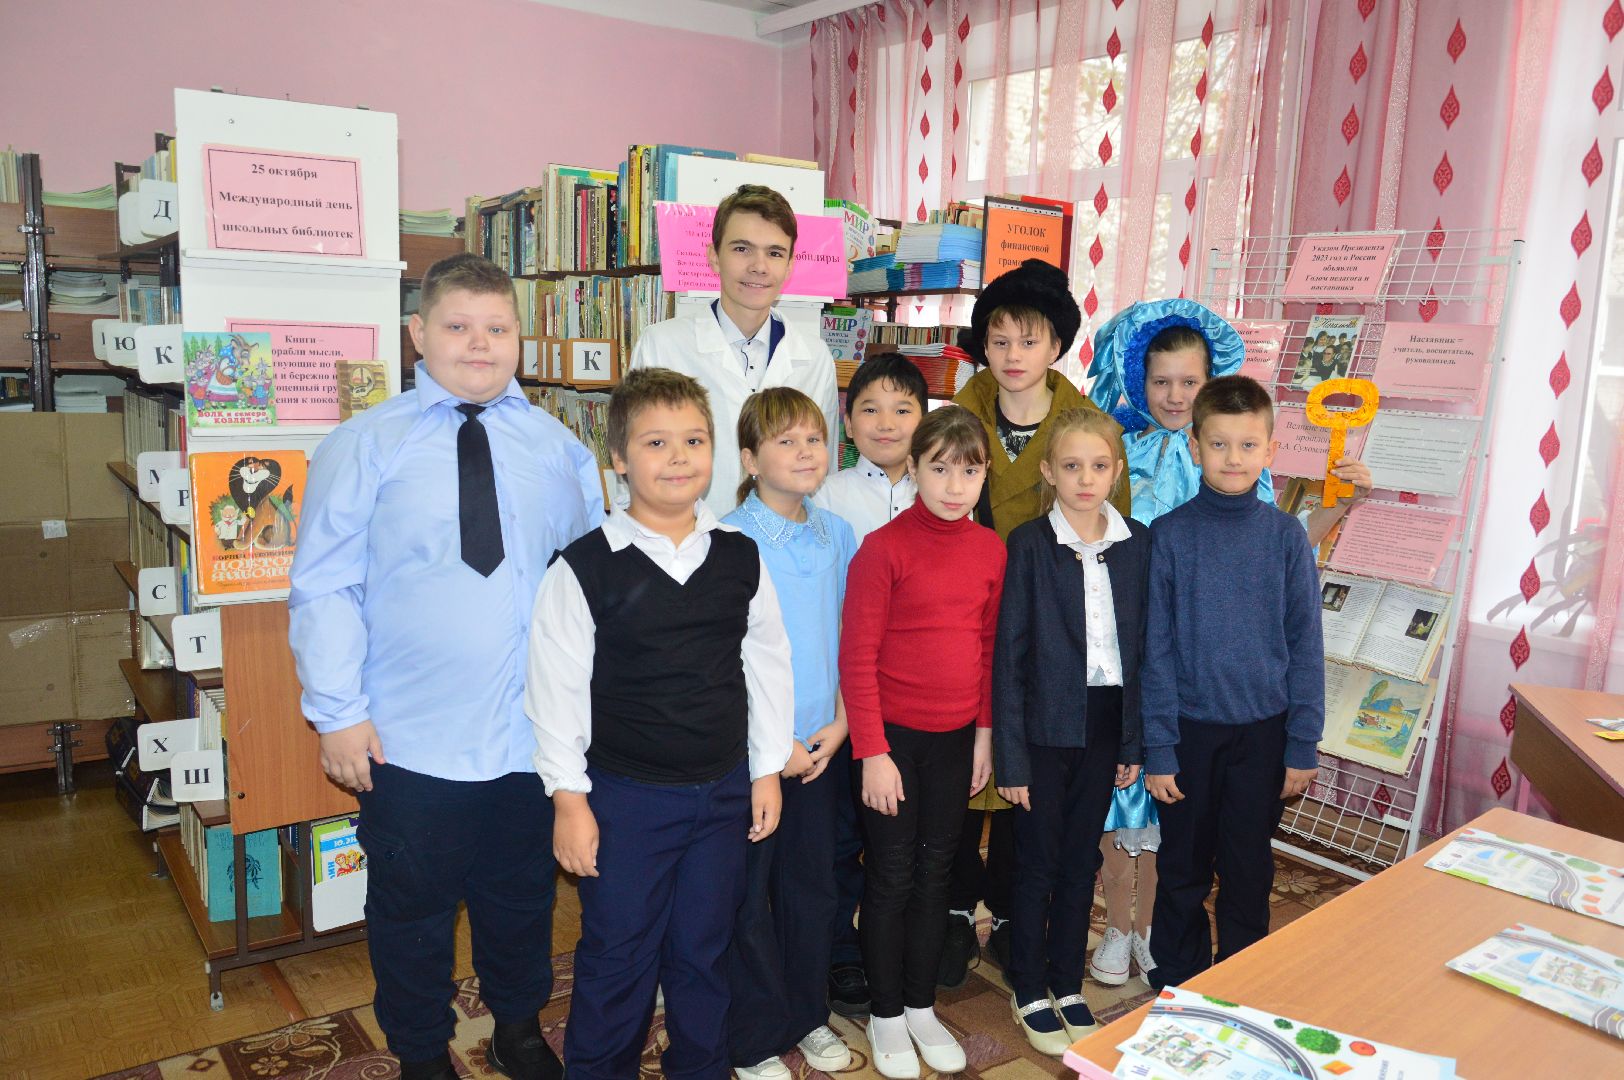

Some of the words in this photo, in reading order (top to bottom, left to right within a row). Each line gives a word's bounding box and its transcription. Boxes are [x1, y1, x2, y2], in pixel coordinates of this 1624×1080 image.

[251, 163, 265, 174] 25
[268, 168, 318, 180] октября
[219, 191, 322, 207] Международный
[325, 201, 353, 210] день
[153, 199, 172, 221] Д
[844, 210, 870, 234] МИР
[222, 223, 289, 235] школьных
[292, 225, 354, 239] библиотек
[1007, 223, 1047, 238] УГОЛОК
[1000, 239, 1050, 254] финансовой
[1340, 244, 1385, 252] Президента
[1311, 254, 1328, 262] 2023
[823, 316, 858, 332] МИР
[114, 336, 136, 351] Ю
[285, 335, 316, 343] Книги
[1409, 335, 1455, 344] Наставник
[155, 345, 175, 365] К
[271, 347, 306, 357] орабли
[309, 349, 344, 357] мысли,
[273, 361, 317, 369] твующие
[584, 350, 602, 371] К
[289, 372, 330, 381] бережно
[276, 384, 320, 392] оценный
[322, 385, 337, 393] гру
[1286, 421, 1319, 431] Великие
[212, 566, 290, 582] АЙБОЛИ
[152, 584, 167, 600] С
[190, 635, 207, 653] Т
[153, 737, 168, 754] Х
[184, 767, 211, 785] Ш
